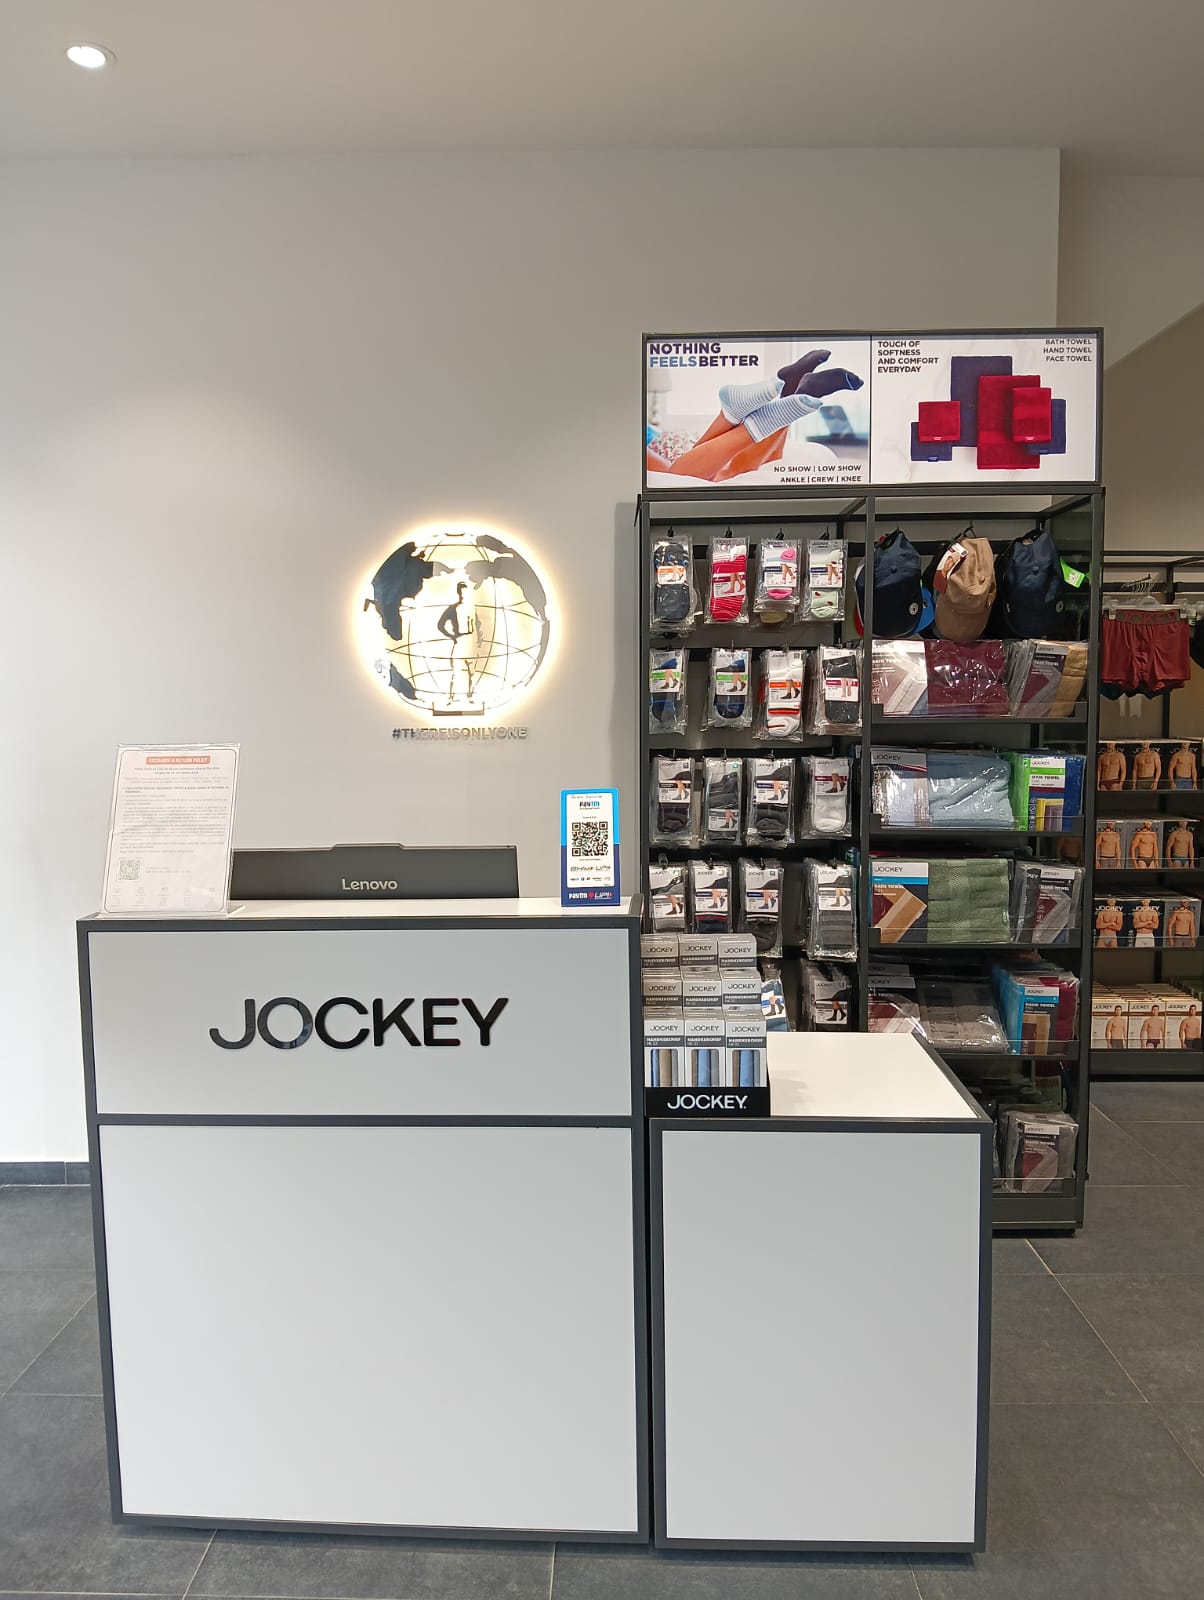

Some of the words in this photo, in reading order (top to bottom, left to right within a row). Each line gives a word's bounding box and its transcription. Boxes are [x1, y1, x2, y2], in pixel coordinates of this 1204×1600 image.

[650, 342, 721, 355] NOTHING
[650, 356, 698, 368] FEELS
[699, 355, 759, 367] BETTER
[392, 727, 528, 740] #THEREISONLYONE
[342, 878, 398, 891] Lenovo
[209, 996, 509, 1050] JOCKEY
